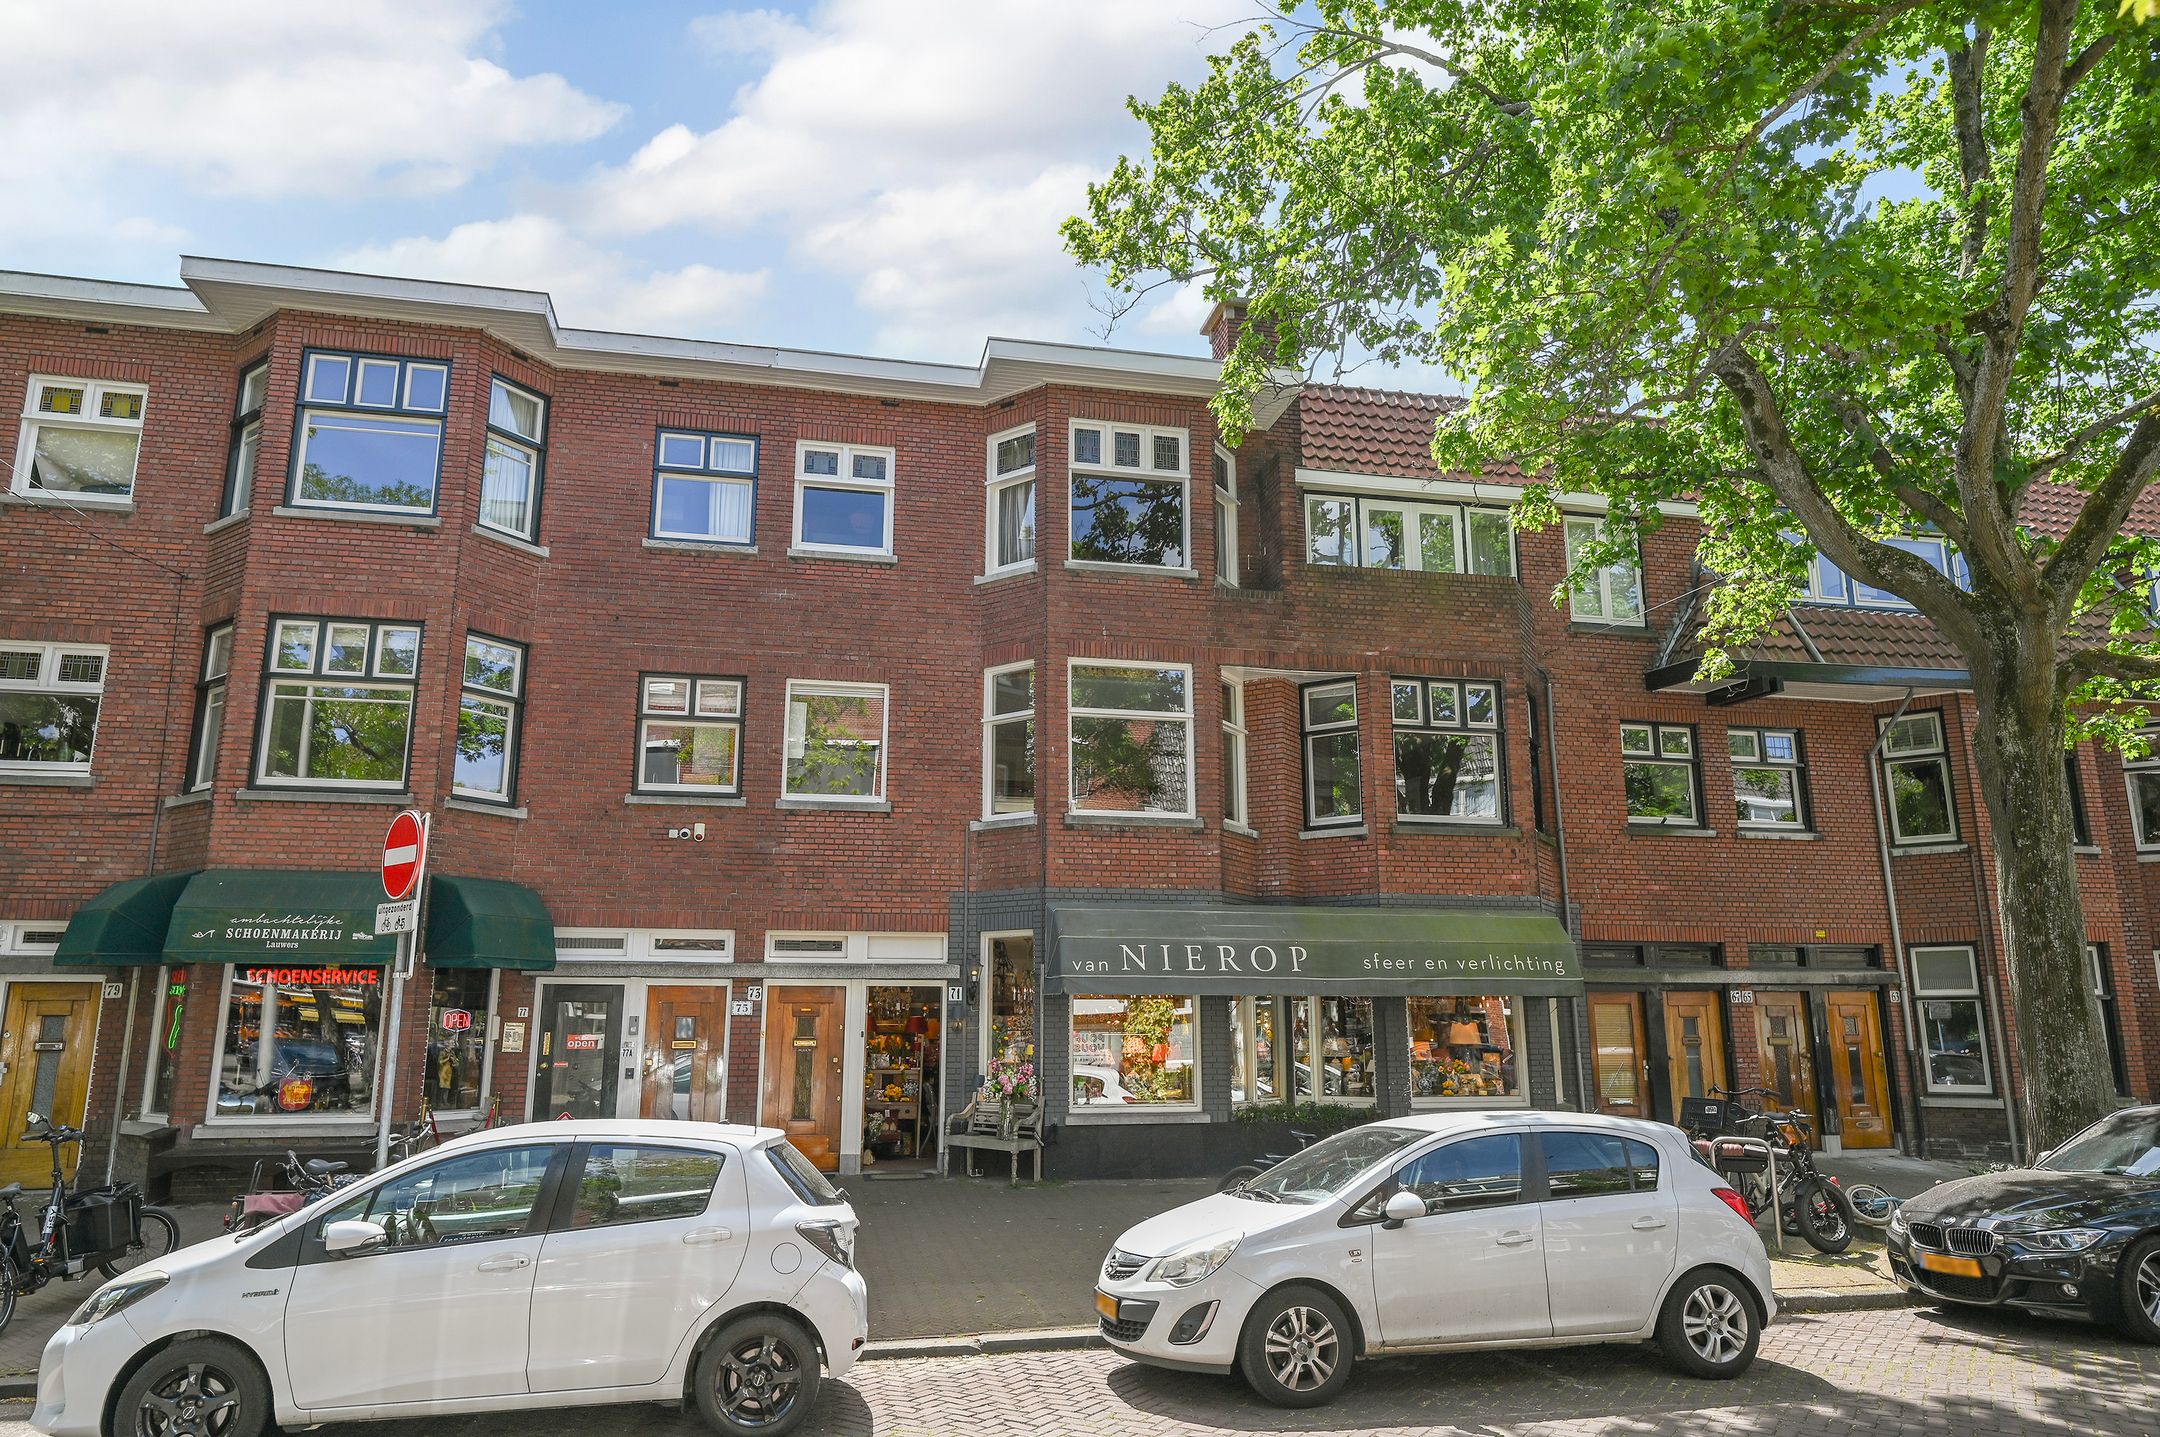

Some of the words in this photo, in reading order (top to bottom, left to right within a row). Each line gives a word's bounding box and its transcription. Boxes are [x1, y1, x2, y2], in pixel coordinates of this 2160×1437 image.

[378, 902, 413, 915] uitgezonderd
[229, 913, 344, 931] ambachtelijke
[225, 928, 343, 941] SCHOENMAKERIJ
[265, 940, 299, 949] Lauwers
[1072, 959, 1109, 972] van
[1118, 943, 1308, 972] NIEROP
[1363, 952, 1415, 970] sfeer
[1424, 958, 1448, 970] en
[1456, 954, 1566, 976] verlichting
[247, 968, 379, 985] SCHOENSERVICE
[107, 984, 121, 996] 79
[749, 987, 761, 999] 73
[951, 987, 960, 1000] 71
[1891, 991, 1900, 1002] 63
[519, 1008, 527, 1017] 77
[736, 1003, 749, 1013] 75
[444, 1013, 470, 1029] OPEN
[567, 1040, 595, 1049] open
[622, 1048, 633, 1057] 77A
